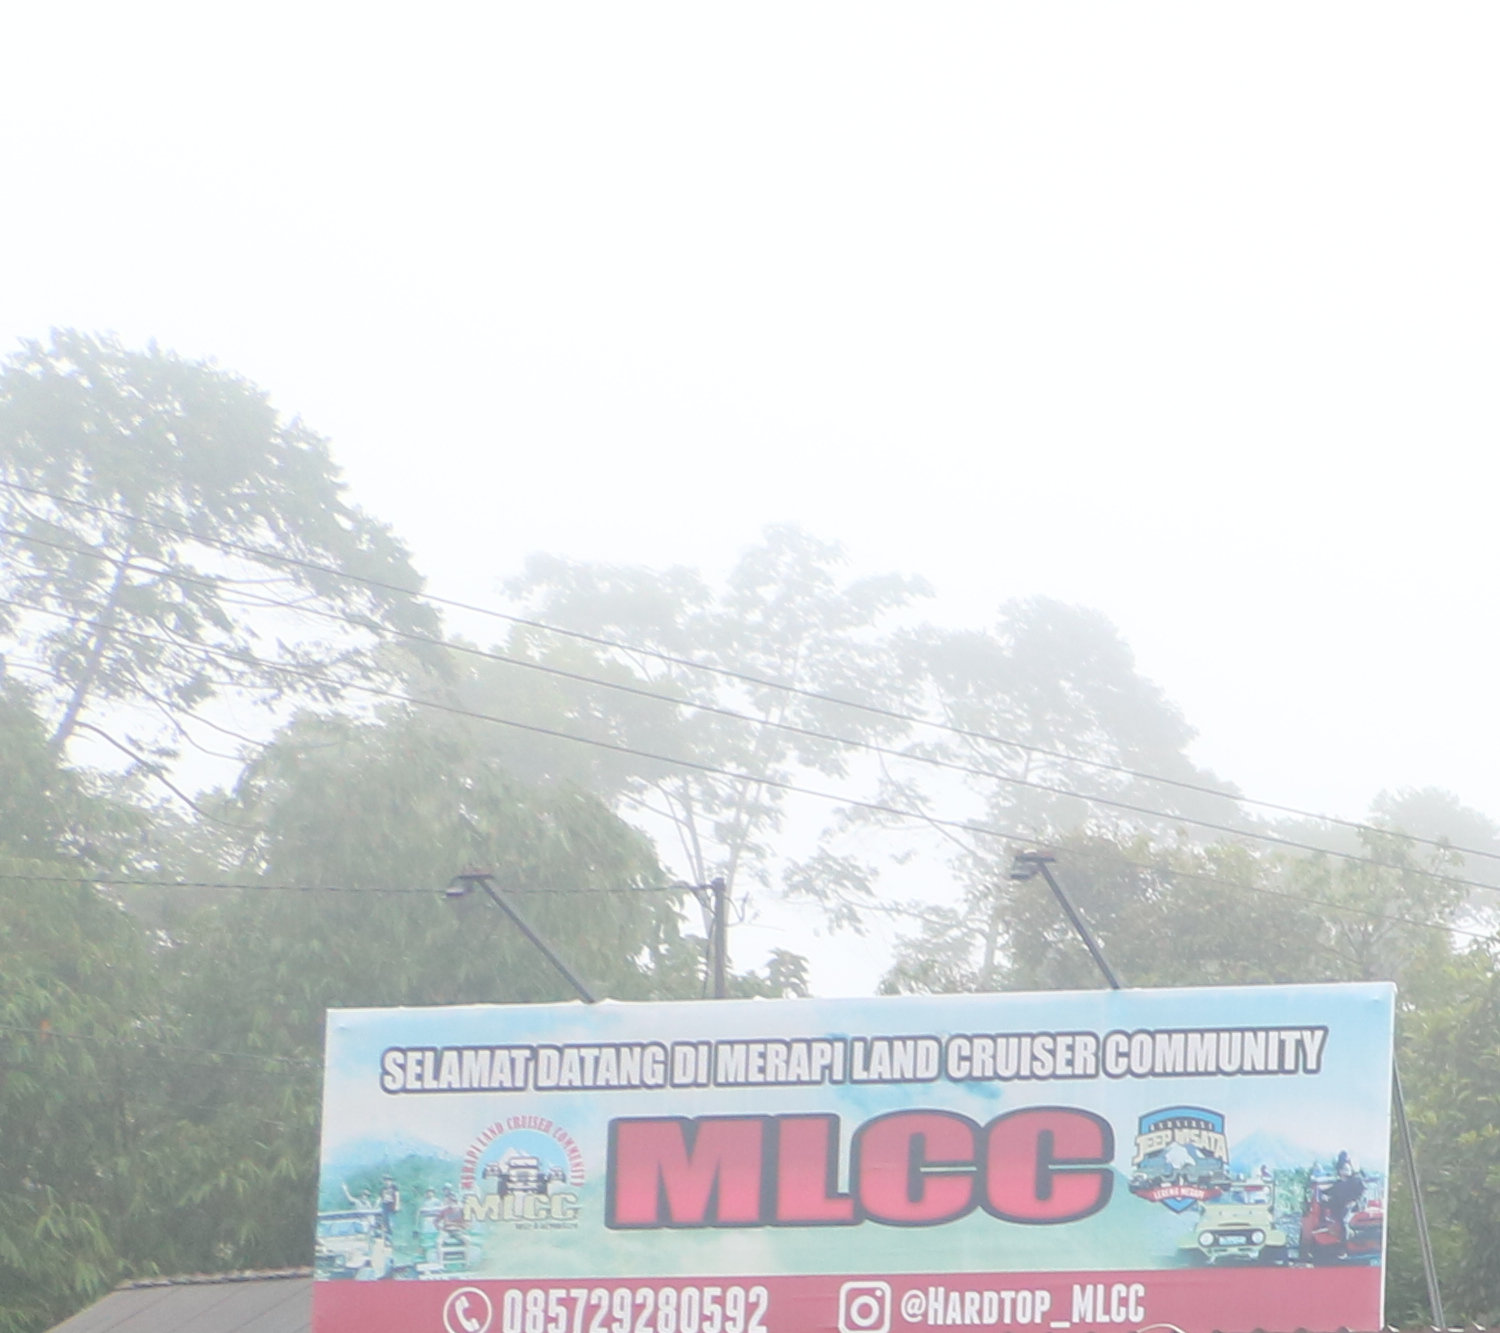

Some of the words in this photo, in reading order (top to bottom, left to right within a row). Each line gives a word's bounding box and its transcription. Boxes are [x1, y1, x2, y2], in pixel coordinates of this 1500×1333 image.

[382, 1046, 531, 1091] SELAMAT
[537, 1044, 667, 1088] DATANG
[673, 1042, 709, 1086] DI
[717, 1039, 843, 1083] MERAPI
[851, 1037, 939, 1081] LAND
[946, 1033, 1098, 1078] CRUISER
[1104, 1028, 1326, 1076] COMMUNITY
[475, 1121, 504, 1149] LAND
[506, 1115, 553, 1134] CRUISER
[1131, 1128, 1173, 1165] JEEP
[1173, 1127, 1230, 1164] WISATA
[607, 1107, 1114, 1228] MLCC
[462, 1193, 580, 1221] MLCC
